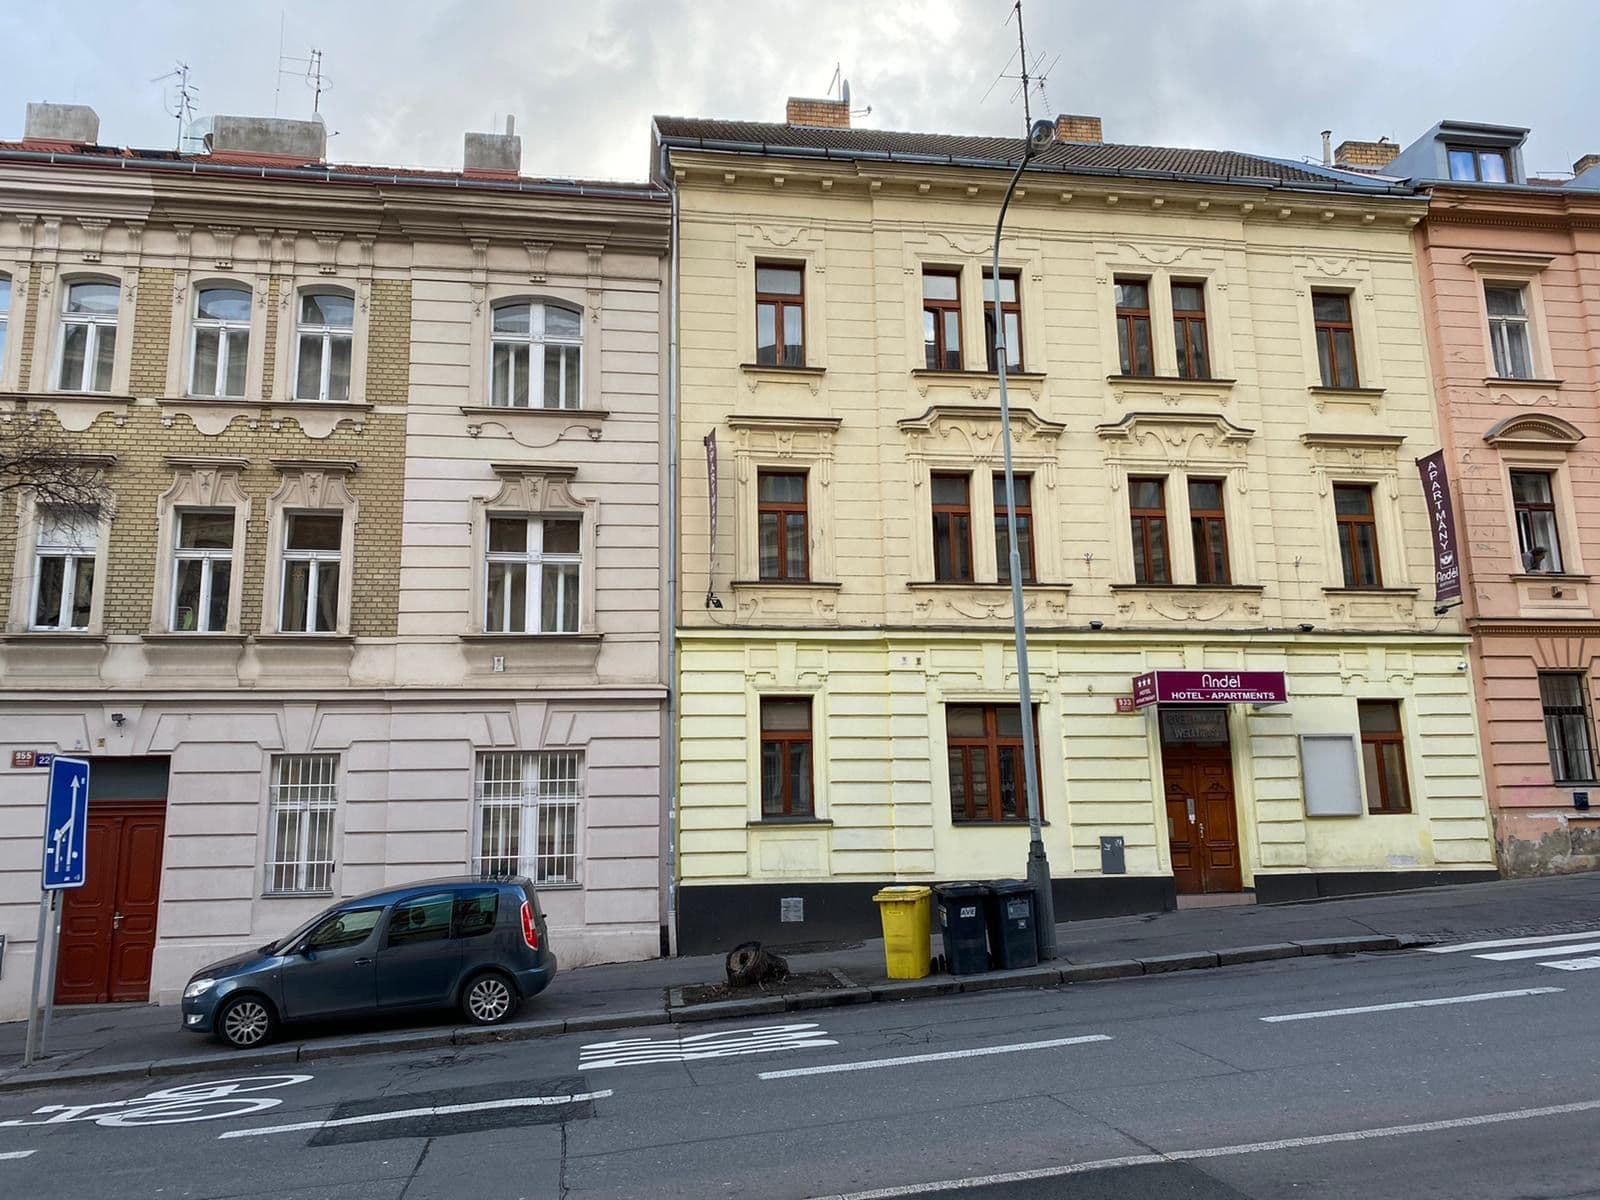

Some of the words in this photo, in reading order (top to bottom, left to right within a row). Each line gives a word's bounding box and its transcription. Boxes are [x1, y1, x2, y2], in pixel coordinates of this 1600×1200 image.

[1427, 461, 1449, 550] APARTMANY
[1171, 691, 1204, 700] HOTEL
[1211, 691, 1276, 700] APARTMENTS
[578, 1023, 839, 1070] BUS
